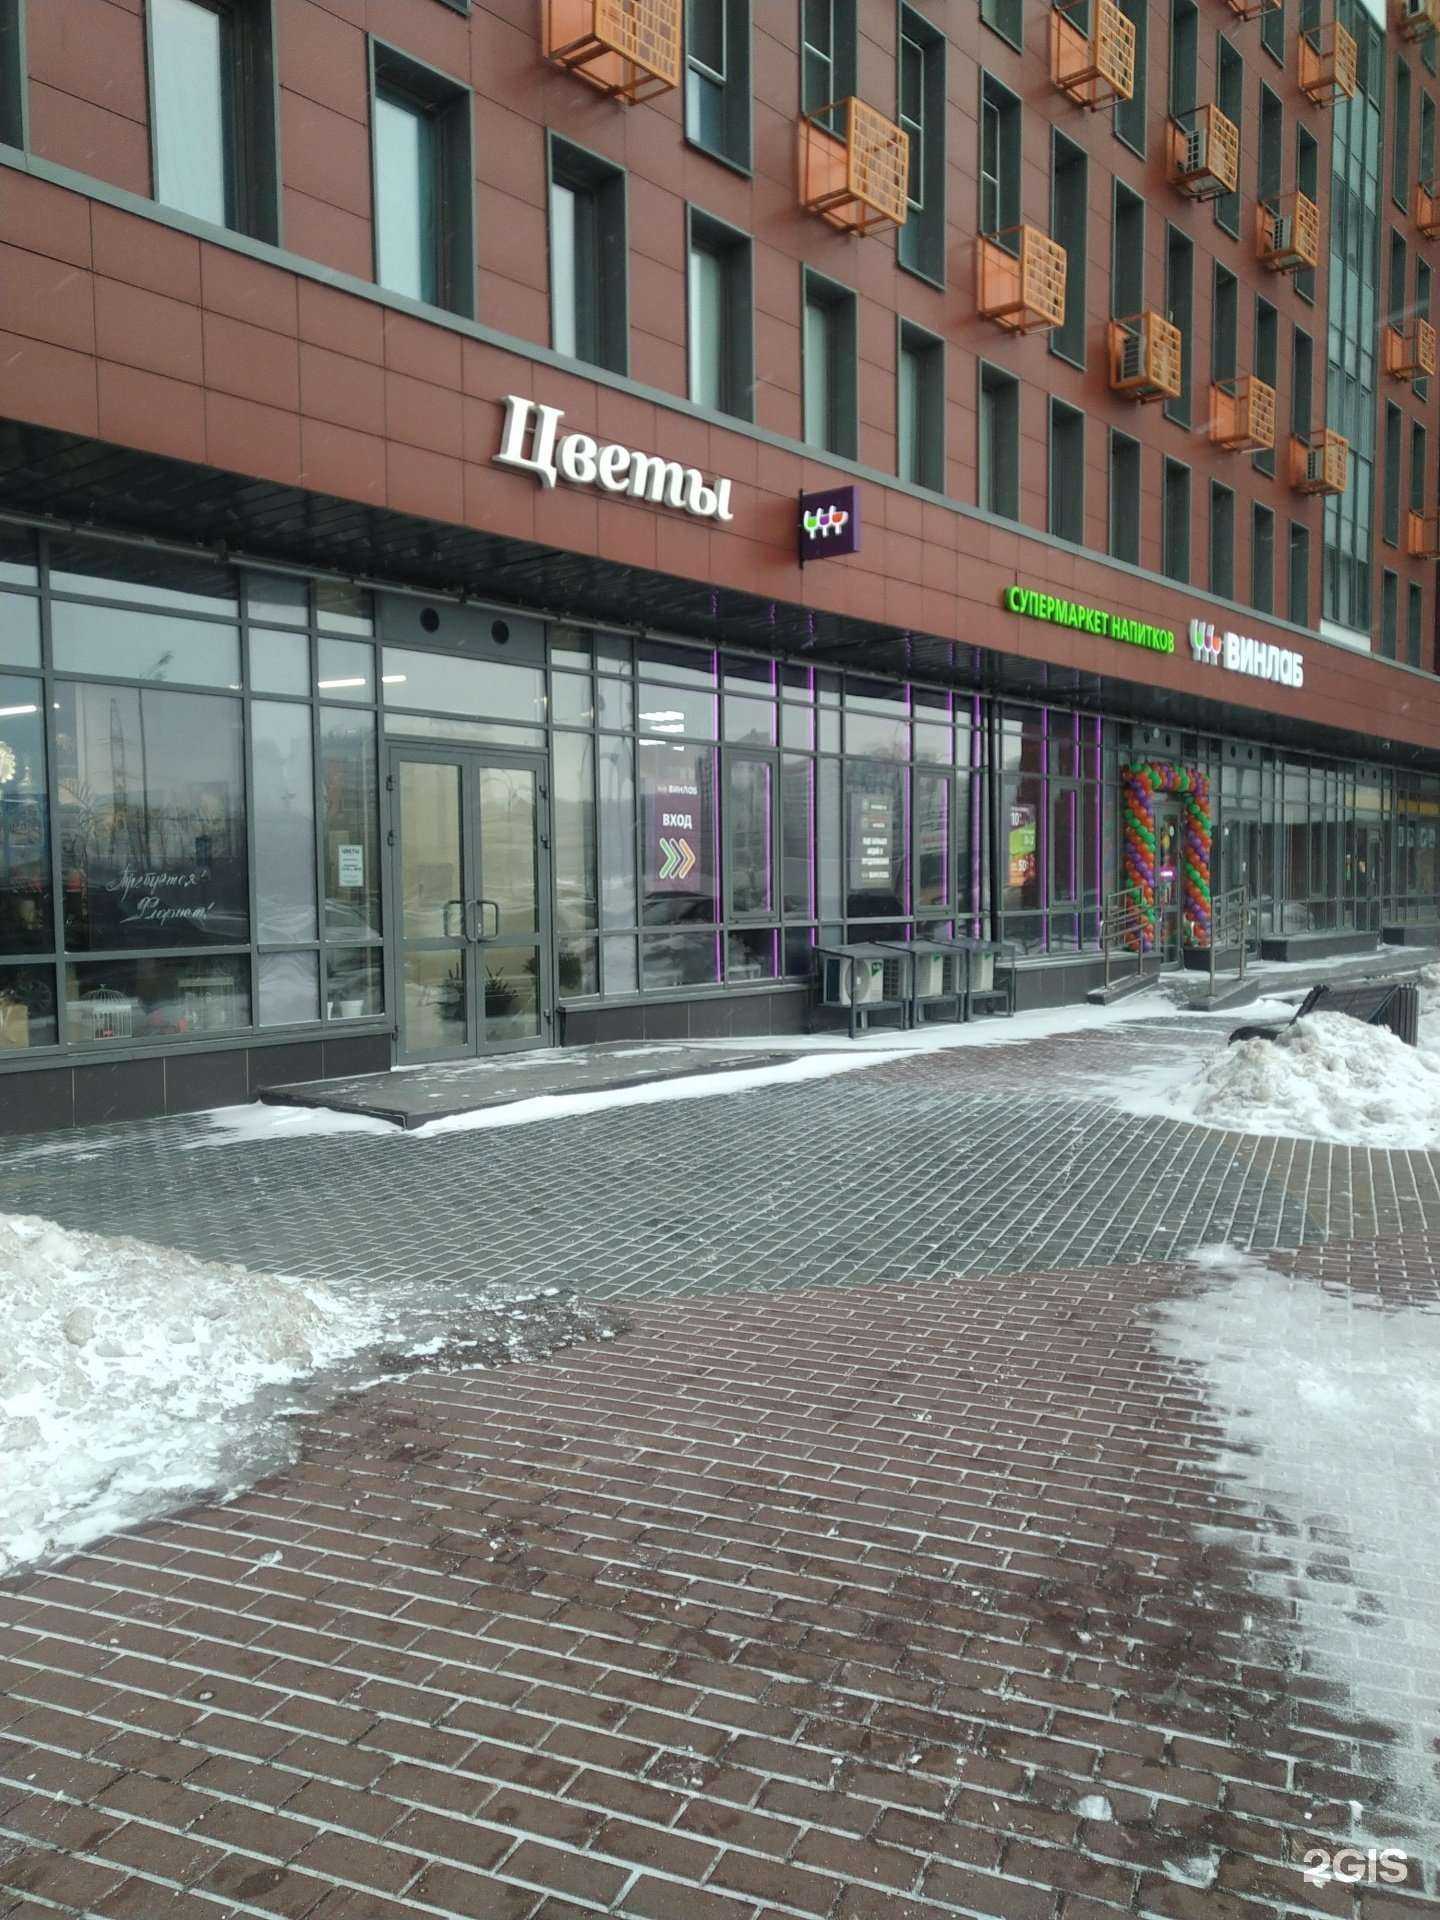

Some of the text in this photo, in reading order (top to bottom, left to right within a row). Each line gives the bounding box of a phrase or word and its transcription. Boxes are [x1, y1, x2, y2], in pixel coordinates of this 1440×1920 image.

[492, 395, 733, 521] Цветы
[1006, 586, 1175, 654] СУПЕРМАРКЕТ НАПИТКОВ
[662, 813, 693, 830] ВХОД
